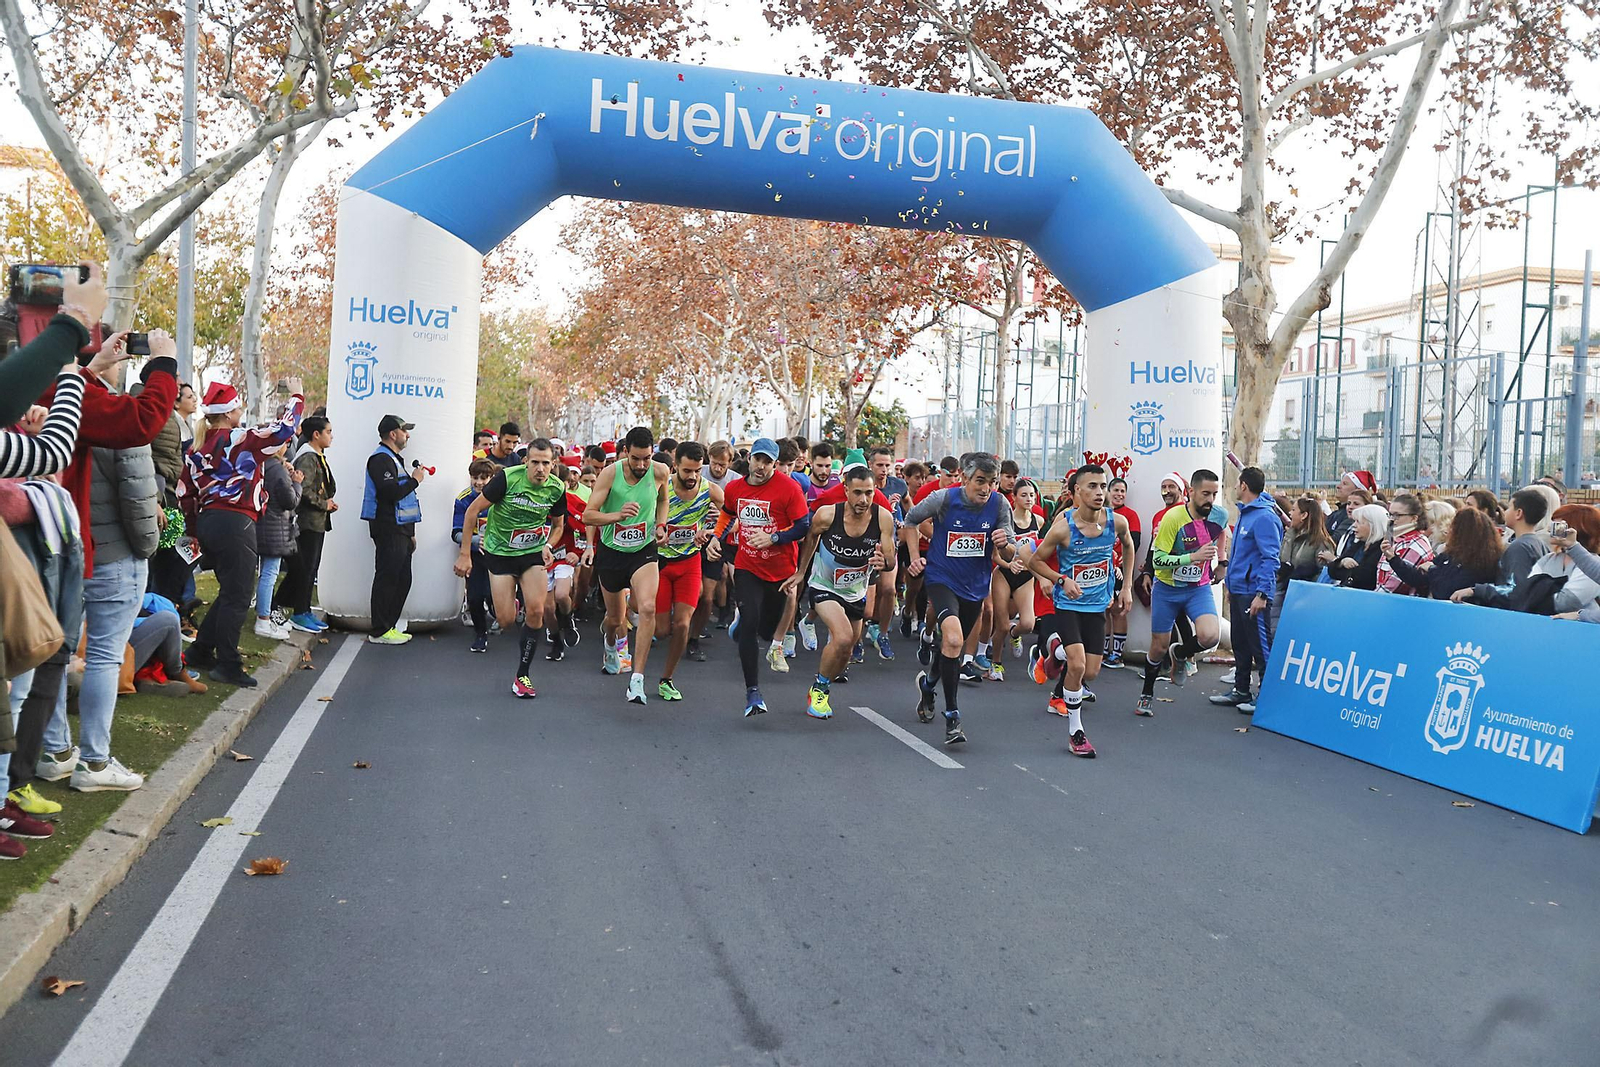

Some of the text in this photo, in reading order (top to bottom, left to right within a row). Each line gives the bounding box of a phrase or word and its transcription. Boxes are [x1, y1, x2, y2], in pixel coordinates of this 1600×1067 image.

[590, 78, 1036, 183] Huelva original
[349, 297, 449, 329] Huelva
[412, 330, 449, 342] original
[382, 372, 435, 383] Ayuntamiento
[1130, 360, 1216, 384] Huelva
[381, 382, 444, 399] HUELVA
[1192, 387, 1216, 396] origina
[1168, 437, 1216, 448] HUELVA
[1280, 639, 1393, 707] Huelva
[1340, 706, 1382, 730] original
[1482, 706, 1574, 740] Ayuntamiento de
[1474, 724, 1565, 772] HUELVA
